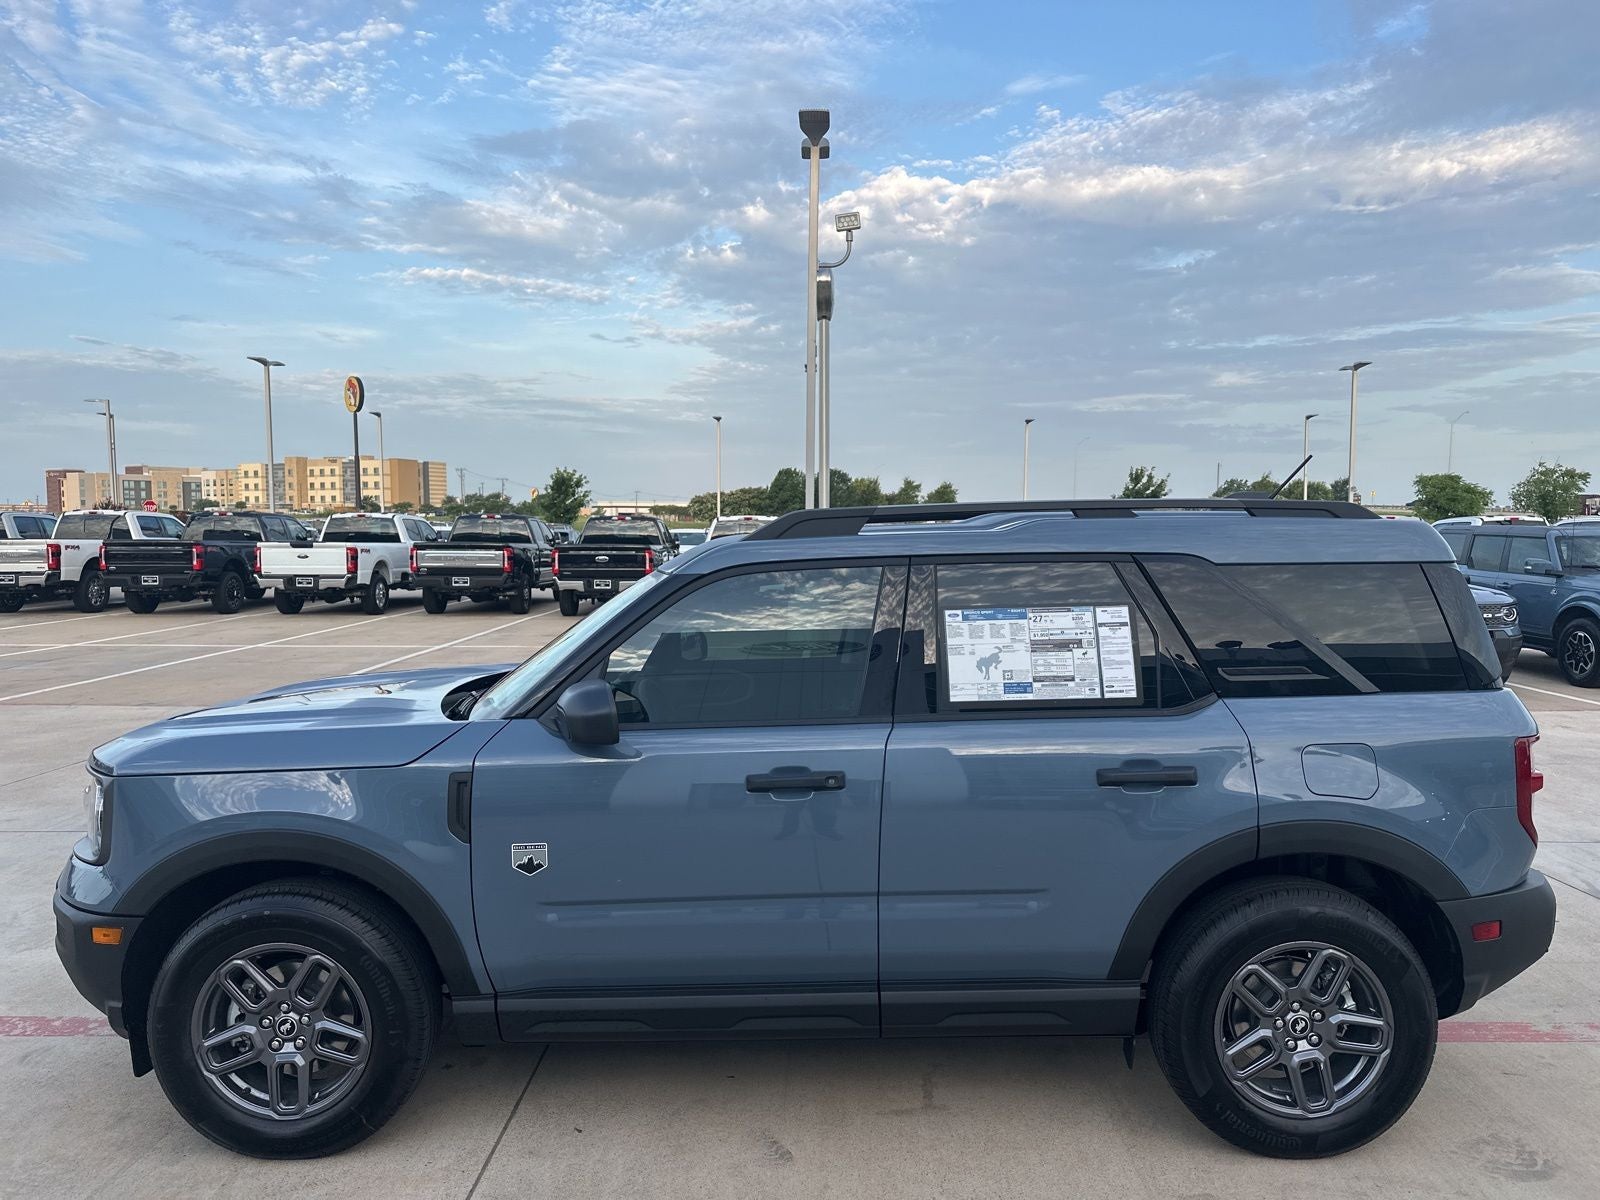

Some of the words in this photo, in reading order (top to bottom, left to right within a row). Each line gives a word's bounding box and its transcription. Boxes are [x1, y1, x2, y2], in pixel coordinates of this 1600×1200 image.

[1032, 615, 1043, 623] 27
[359, 952, 404, 1036] Continenl
[1219, 1108, 1304, 1152] Continental
